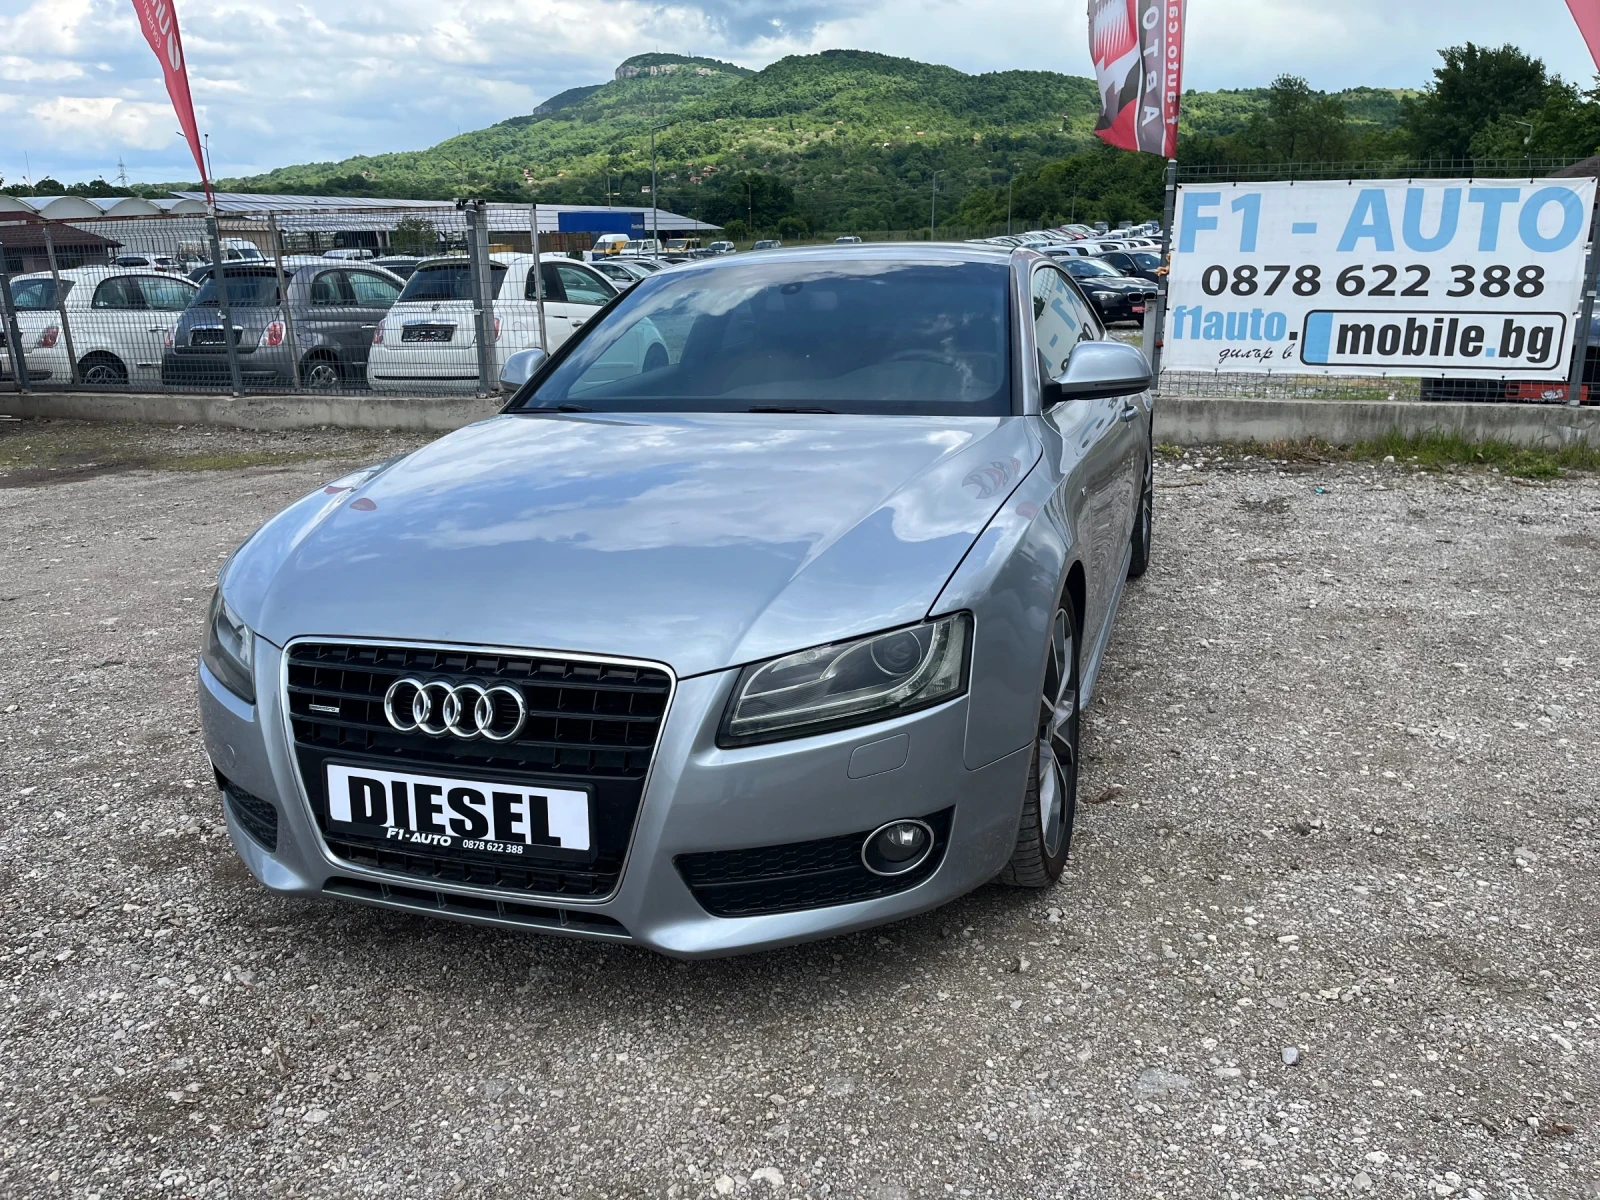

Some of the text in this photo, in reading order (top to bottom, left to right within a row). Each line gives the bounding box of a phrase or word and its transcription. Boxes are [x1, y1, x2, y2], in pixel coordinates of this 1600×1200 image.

[1178, 192, 1262, 253] F1
[1336, 187, 1584, 253] AUTO
[1201, 264, 1545, 298] 0878 622 388
[1336, 317, 1554, 363] mobile.bg
[348, 776, 562, 848] DIESEL
[386, 827, 452, 847] F1-AUTO
[462, 839, 524, 855] 0878 622 388
